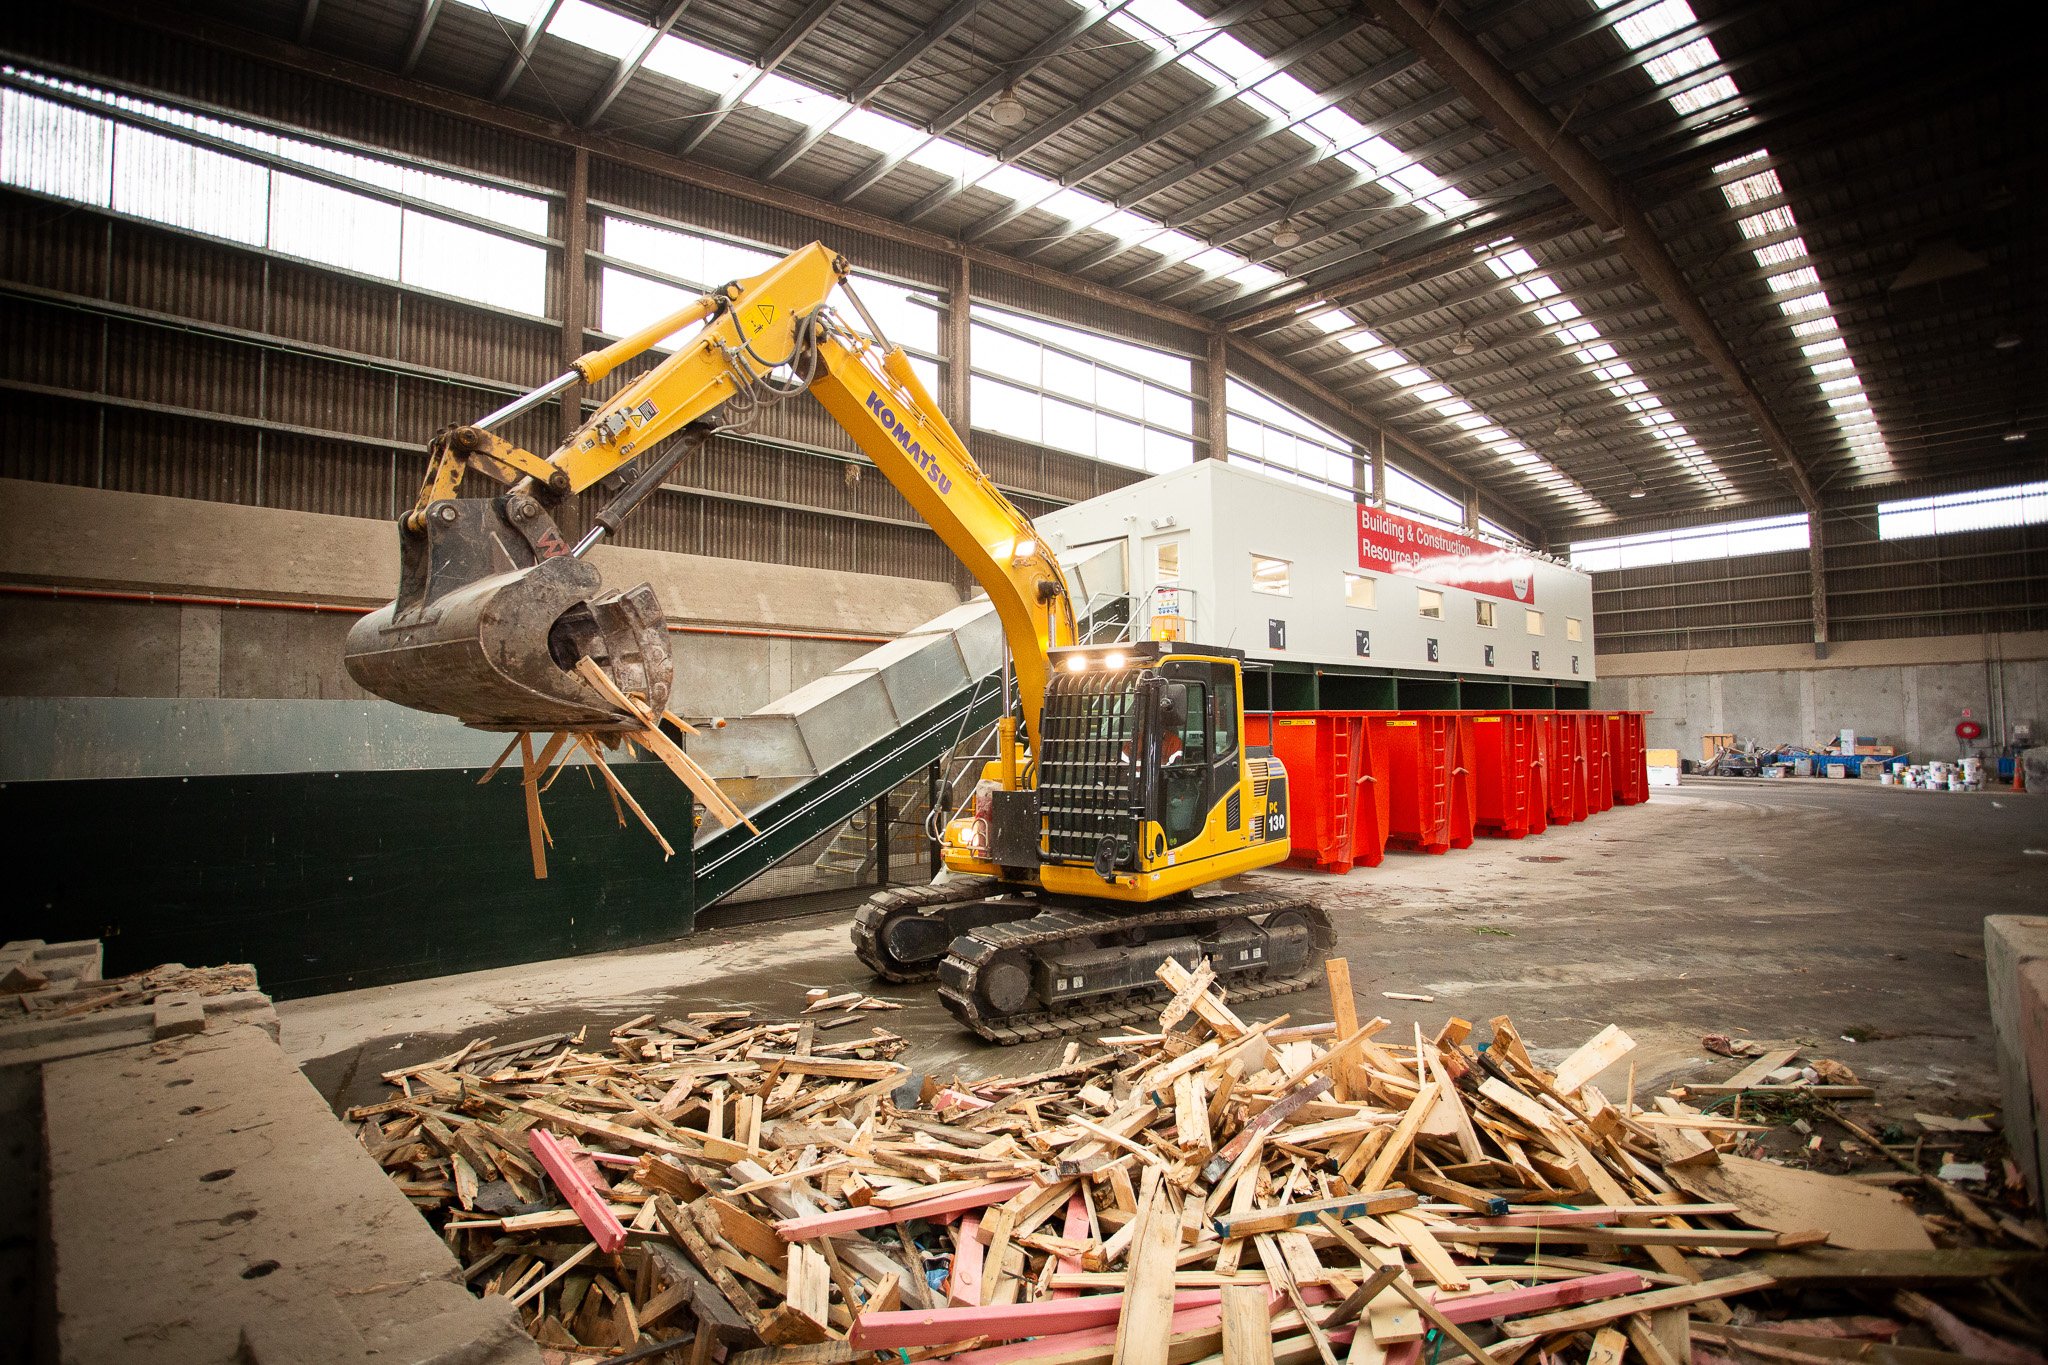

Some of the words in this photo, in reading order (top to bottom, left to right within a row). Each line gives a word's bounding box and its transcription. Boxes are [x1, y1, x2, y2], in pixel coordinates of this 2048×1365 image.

[865, 390, 952, 495] KOMATSU
[1361, 510, 1405, 543] Building
[1406, 524, 1414, 542] &
[1416, 527, 1471, 556] Construction
[1362, 538, 1411, 563] Resource
[1277, 627, 1284, 646] 1
[1362, 637, 1370, 654] 2
[1432, 644, 1438, 660] 3
[1488, 650, 1494, 664] 4
[1535, 655, 1540, 669] 5
[1574, 660, 1580, 672] 6
[1269, 801, 1278, 814] PC
[1268, 814, 1285, 831] 130
